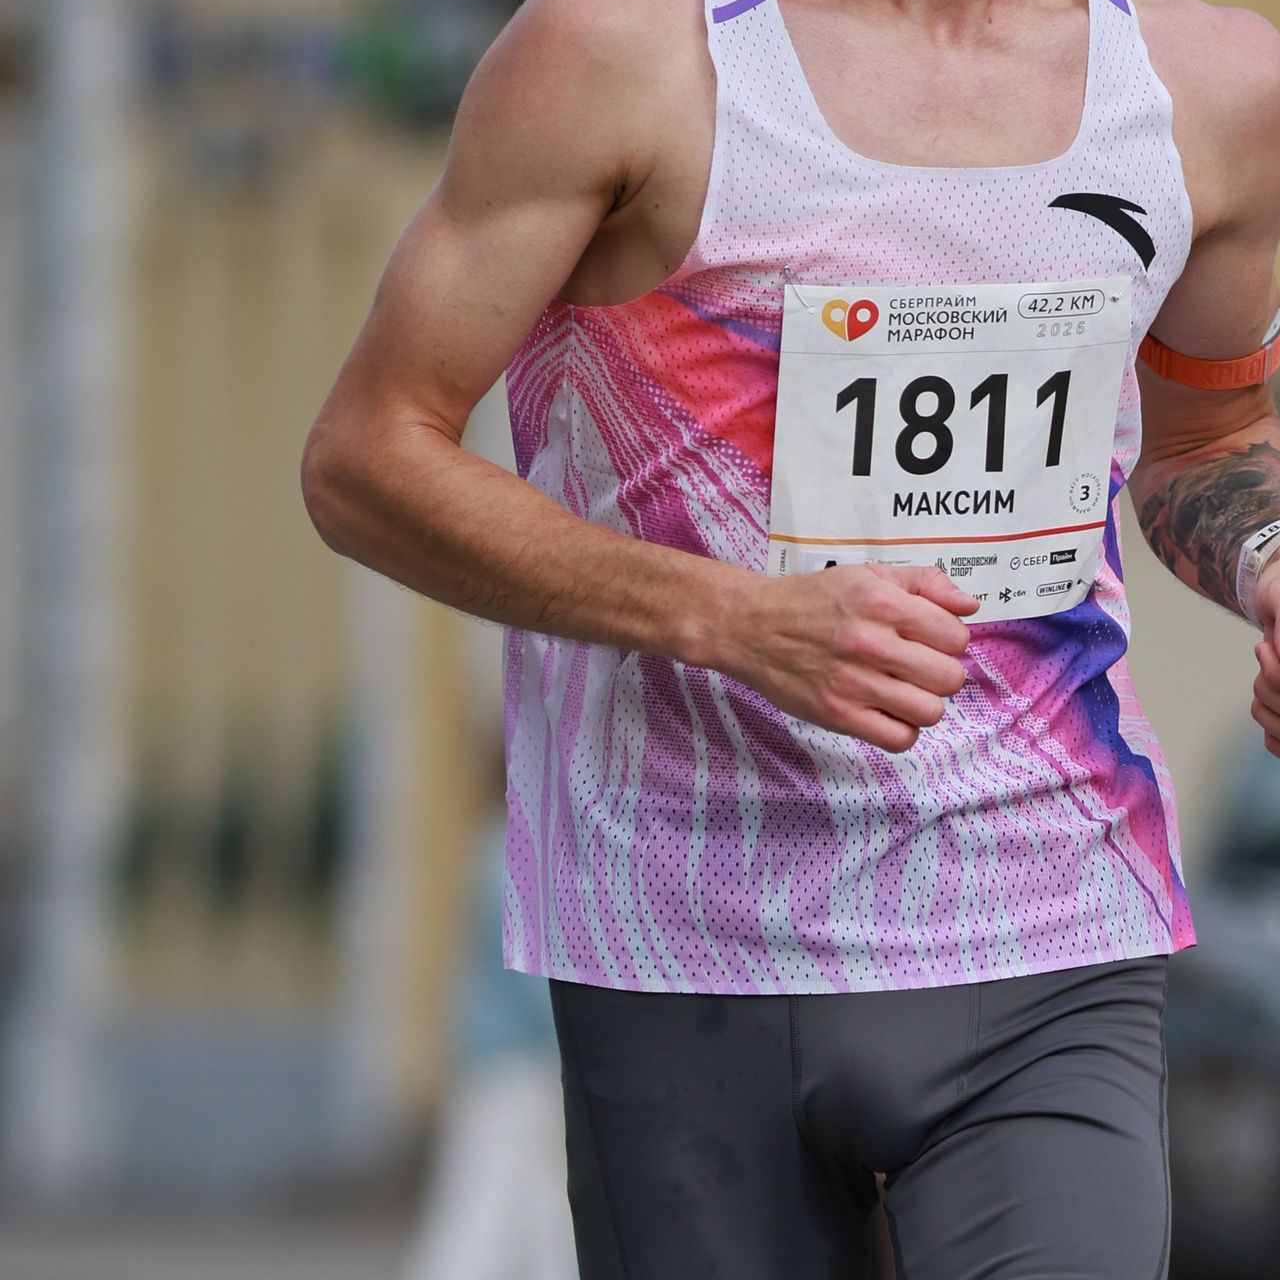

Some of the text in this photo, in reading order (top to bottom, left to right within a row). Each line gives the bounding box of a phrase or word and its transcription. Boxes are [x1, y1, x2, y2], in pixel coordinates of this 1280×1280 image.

[889, 294, 976, 309] СБЕРПРАЙМ
[1027, 297, 1064, 314] 42,2
[888, 308, 1008, 326] МОСКОВСКИЙ
[887, 327, 975, 342] МАРАФОН
[1036, 321, 1086, 338] 2026
[835, 370, 1072, 477] 1811
[1079, 485, 1090, 501] 3
[893, 489, 1015, 517] МАКСИМ
[950, 554, 998, 567] МОСКОВСКИЙ
[1023, 555, 1048, 567] СБЕР
[950, 567, 973, 577] СПОРТ
[1039, 583, 1066, 594] WINLINE
